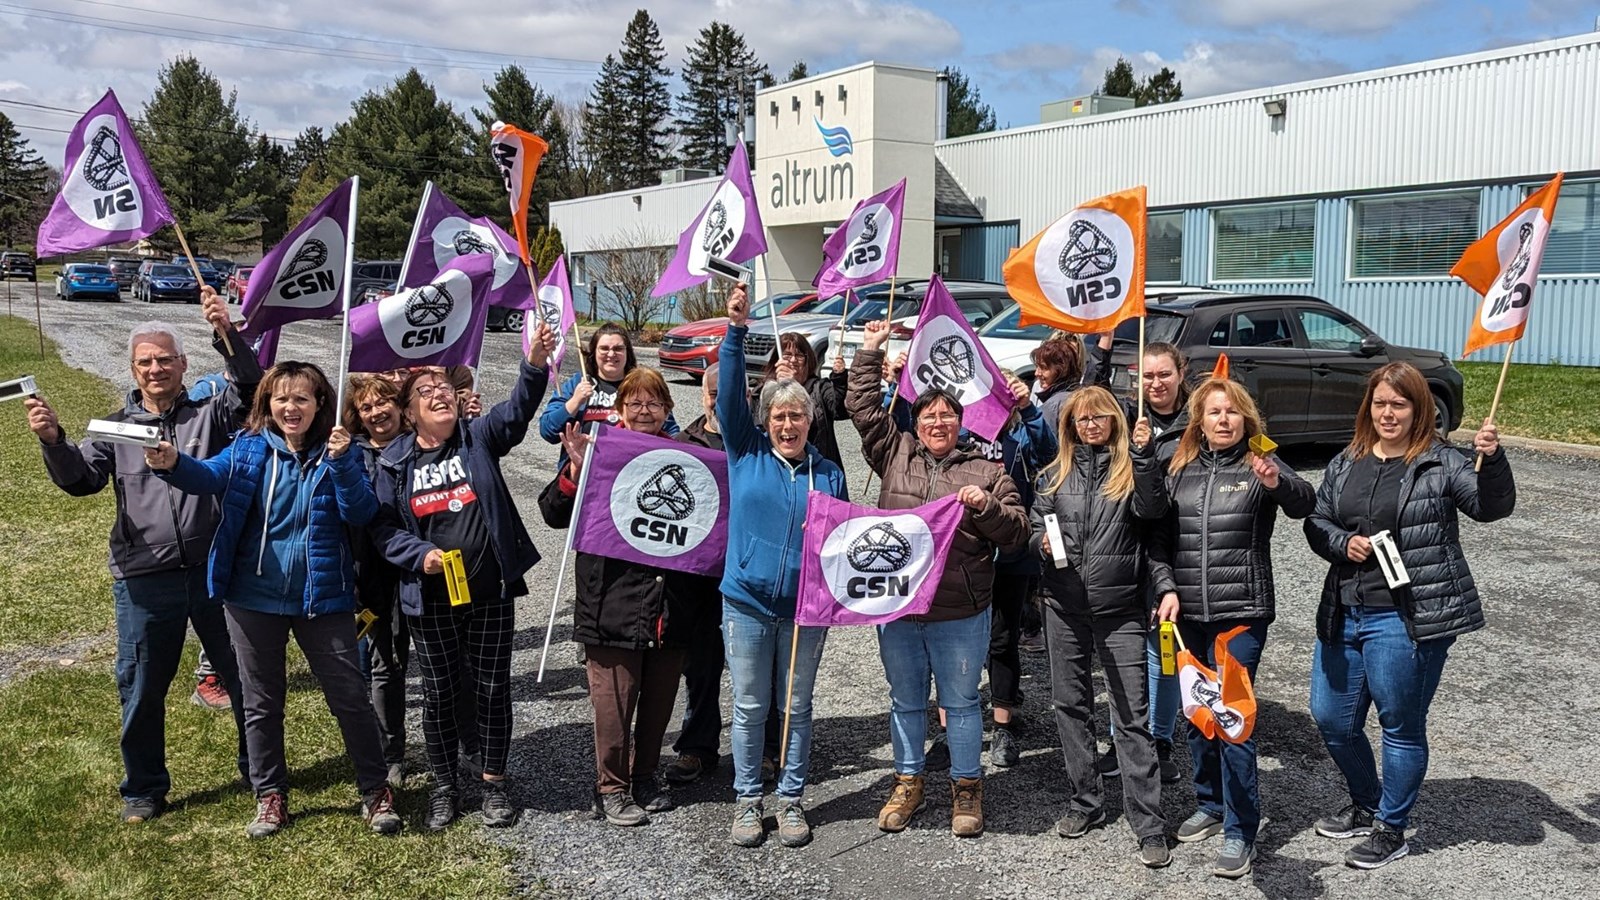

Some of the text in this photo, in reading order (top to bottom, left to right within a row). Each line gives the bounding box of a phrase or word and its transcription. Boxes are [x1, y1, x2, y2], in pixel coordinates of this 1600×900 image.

[770, 158, 854, 209] altrum
[710, 227, 735, 258] SN
[279, 269, 336, 300] CSN
[401, 325, 447, 349] CSN
[588, 389, 618, 408] RESP
[415, 491, 450, 507] AVANT
[1219, 484, 1249, 493] altrum
[630, 516, 689, 547] CSN
[846, 574, 910, 599] CSN
